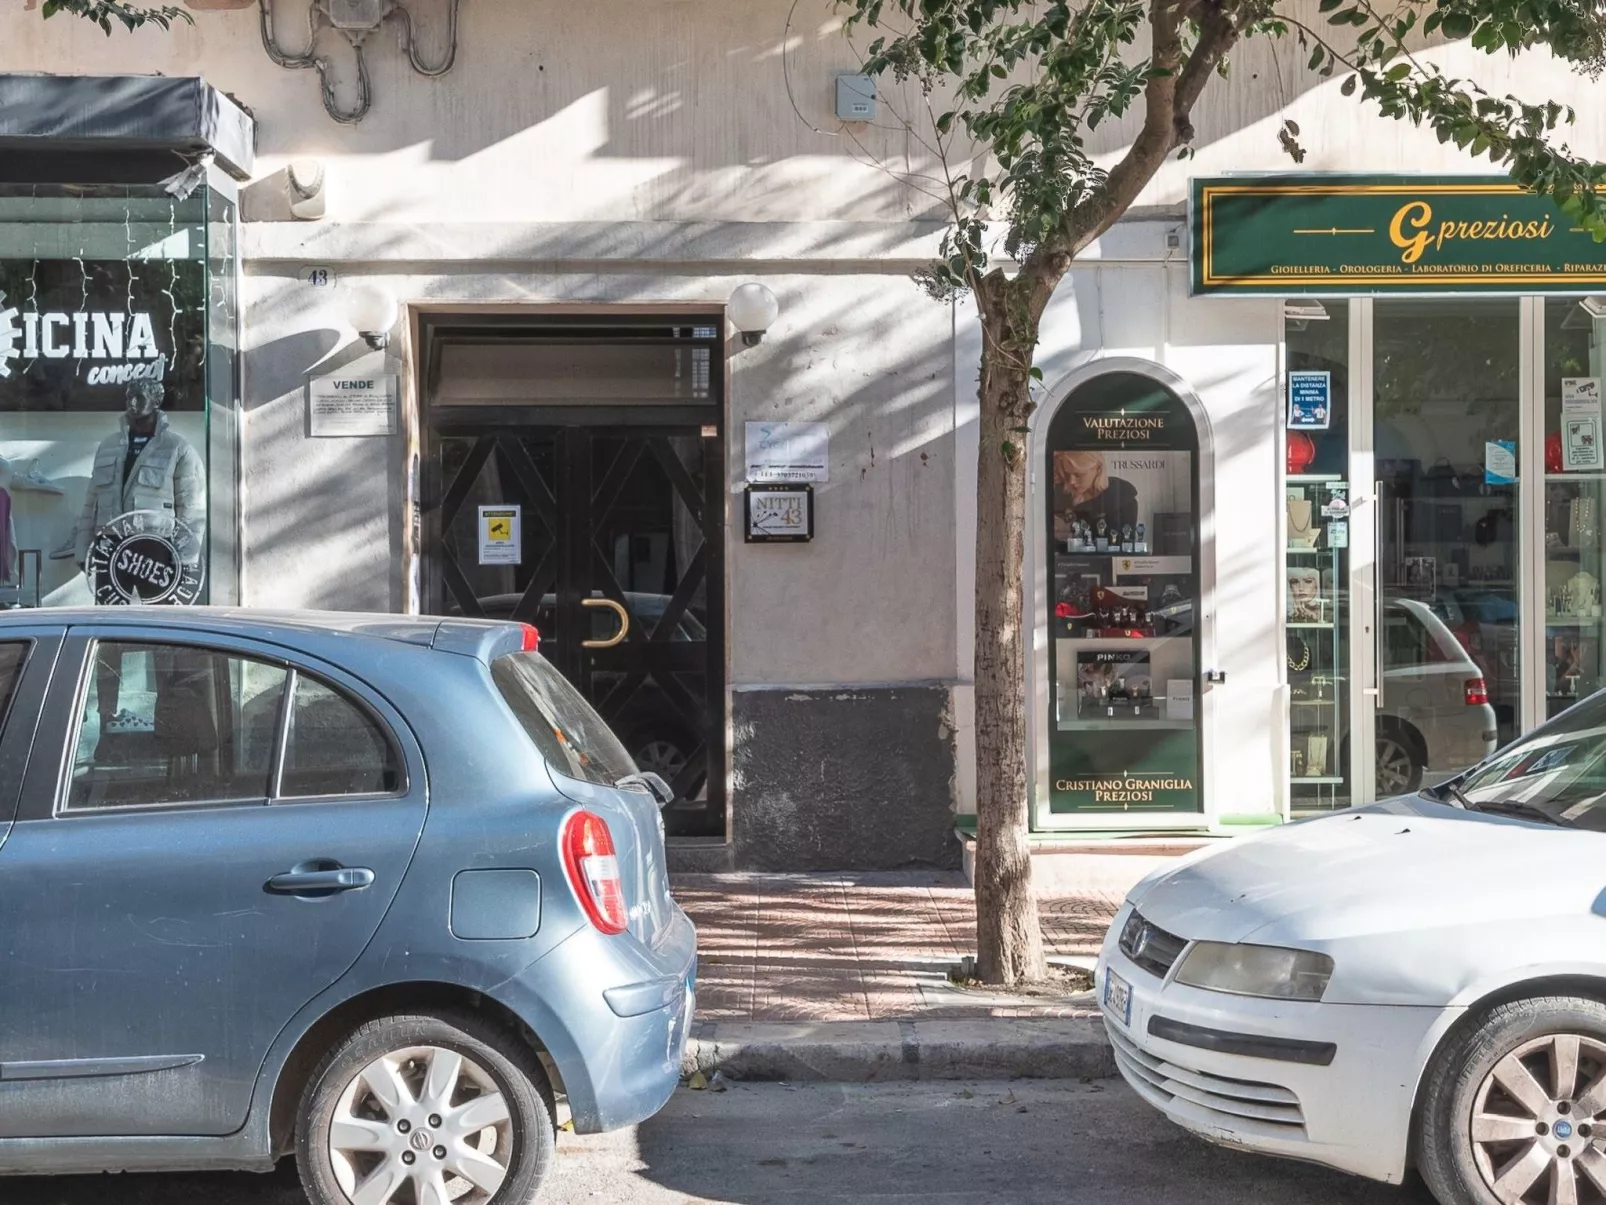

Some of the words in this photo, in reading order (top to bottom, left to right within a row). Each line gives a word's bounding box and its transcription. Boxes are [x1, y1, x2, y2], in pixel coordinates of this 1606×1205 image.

[1436, 213, 1555, 251] preziosi
[1270, 264, 1330, 274] GIOIELLERIA
[1339, 264, 1402, 274] OROLOGERIA
[1411, 263, 1479, 274] LABORATORIO
[1495, 263, 1552, 273] OREFICERIA
[308, 269, 329, 287] 43
[333, 380, 375, 390] VENDE
[1083, 417, 1165, 429] VALUTAZIONE
[1097, 428, 1151, 440] PREZIOSI
[1111, 460, 1166, 470] TRUSSARDI
[756, 497, 802, 510] NITTI
[780, 508, 802, 525] 43
[117, 549, 174, 588] SHOES
[1096, 653, 1132, 661] PINKO
[1055, 779, 1123, 791] CRISTIANO
[1125, 778, 1192, 790] GRANIGLIA
[1095, 790, 1153, 802] PREZIOSI
